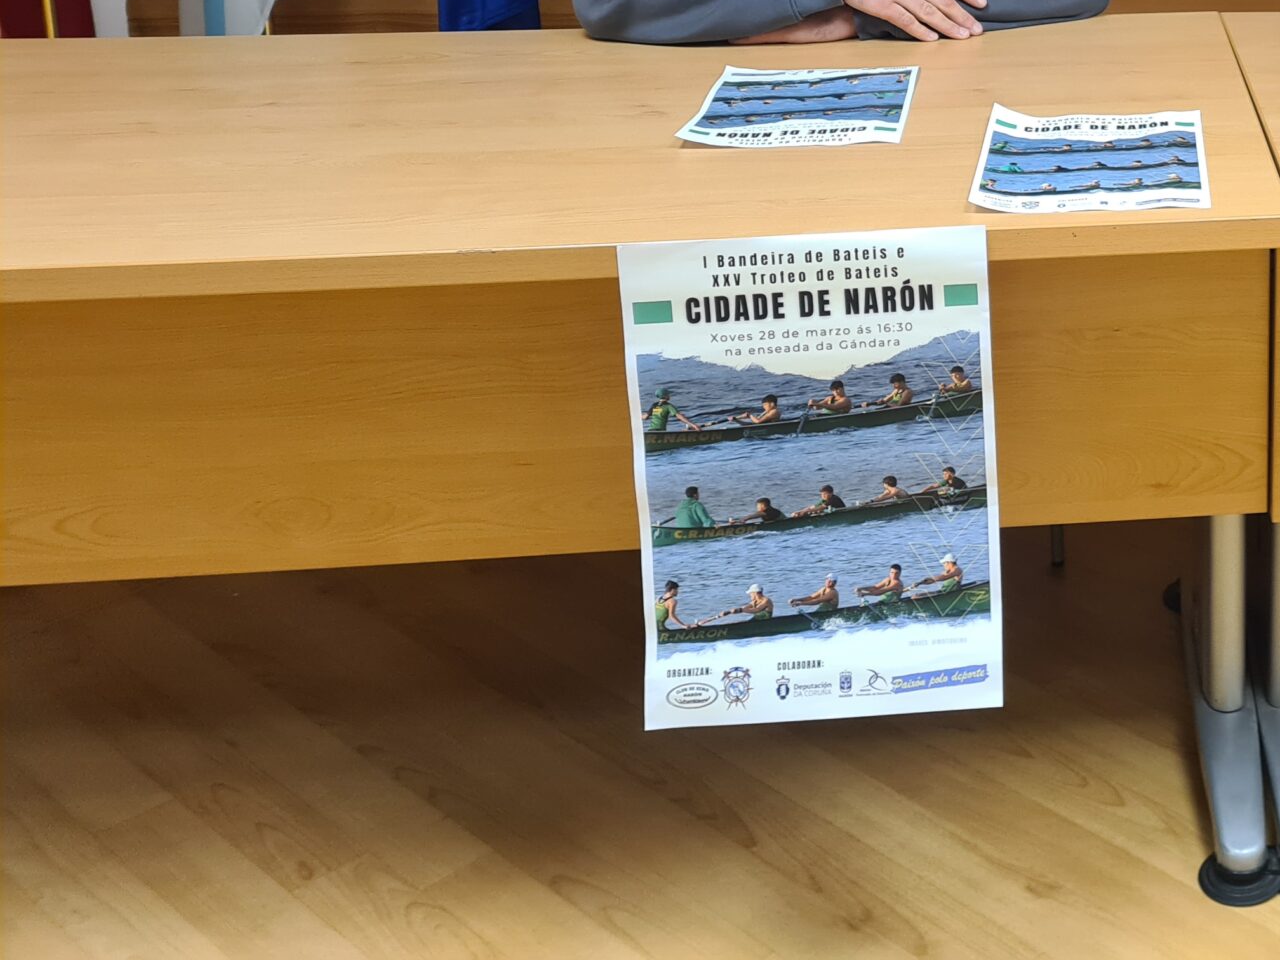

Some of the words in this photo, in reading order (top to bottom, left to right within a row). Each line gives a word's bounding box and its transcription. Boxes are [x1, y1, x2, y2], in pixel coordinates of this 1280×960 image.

[1024, 123, 1082, 133] CIDADE
[1089, 123, 1109, 131] DE
[702, 255, 707, 269] I
[717, 251, 795, 268] Bandeira
[804, 250, 823, 263] de
[833, 246, 887, 262] Bateis
[897, 246, 905, 259] e
[711, 273, 741, 288] XXV
[750, 270, 806, 285] Trofeo
[816, 268, 835, 281] de
[844, 264, 898, 280] Bateis
[685, 292, 786, 324] CIDADE
[798, 289, 831, 318] DE
[844, 278, 934, 315] NARÓN
[710, 332, 753, 343] Xoves
[759, 330, 776, 341] 28
[781, 328, 799, 339] de
[805, 326, 851, 338] marzo
[856, 324, 872, 335] ás
[877, 321, 913, 333] 16:30
[724, 348, 742, 357] na
[748, 342, 810, 355] enseada
[815, 341, 833, 351] da
[839, 337, 901, 350] Gándara
[666, 666, 713, 679] ORGANIZAN:
[776, 659, 825, 671] COLABORAN:
